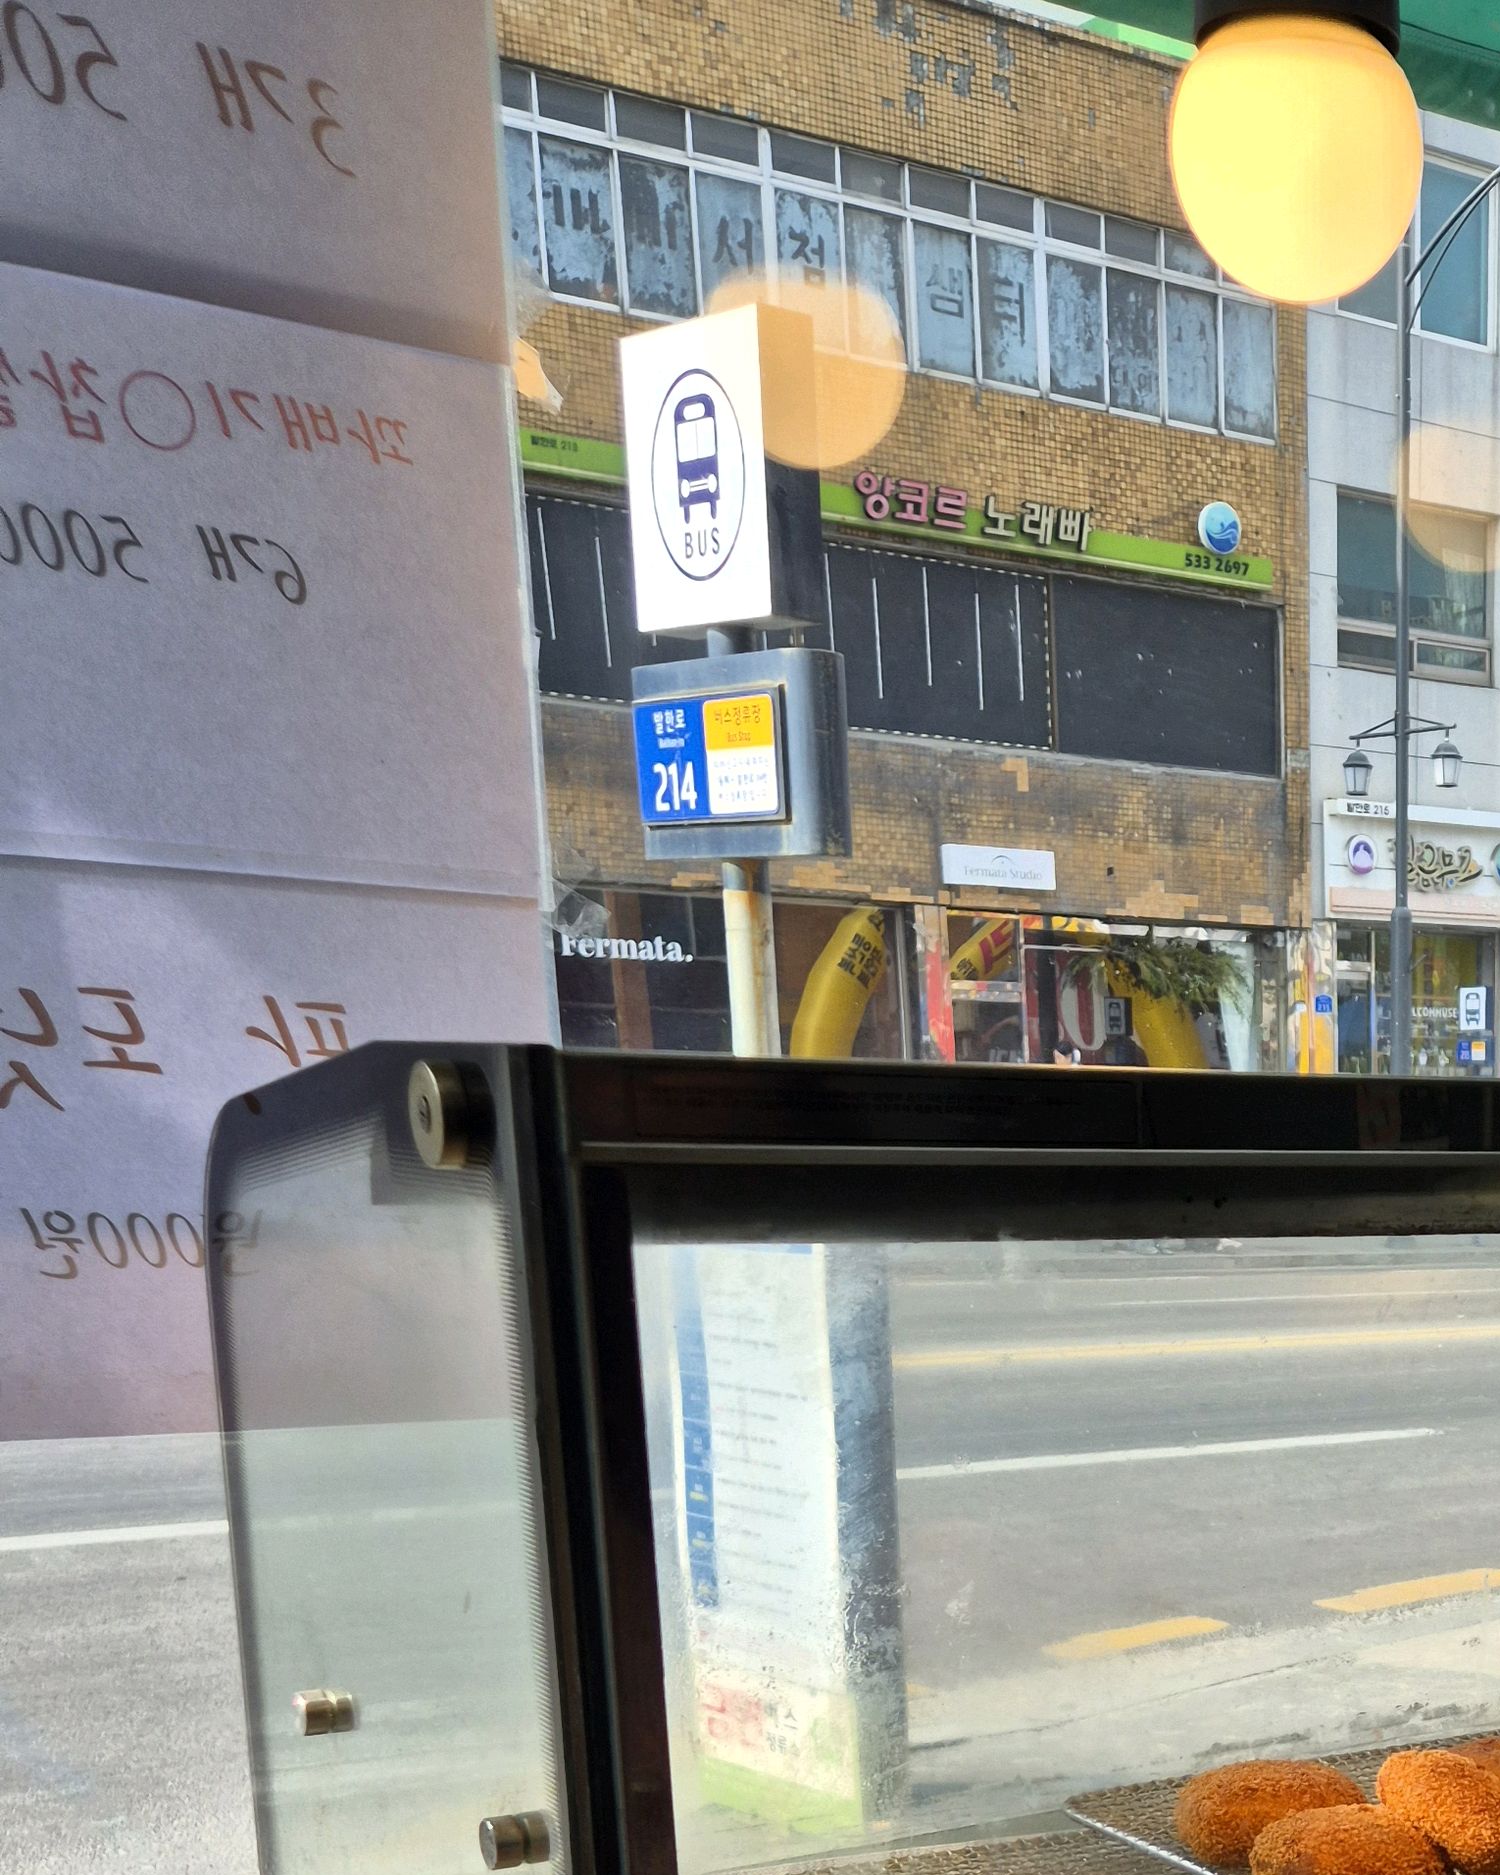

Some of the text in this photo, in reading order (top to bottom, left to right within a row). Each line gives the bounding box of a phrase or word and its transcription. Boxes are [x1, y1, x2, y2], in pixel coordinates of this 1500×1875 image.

[854, 469, 1095, 552] 앙코르 노래빠
[685, 527, 720, 559] BUS
[1184, 553, 1250, 577] 533 2697
[653, 709, 686, 735] 발한로
[653, 761, 698, 812] 214
[964, 866, 1043, 881] Fermata Studio
[560, 934, 694, 963] Fermata.
